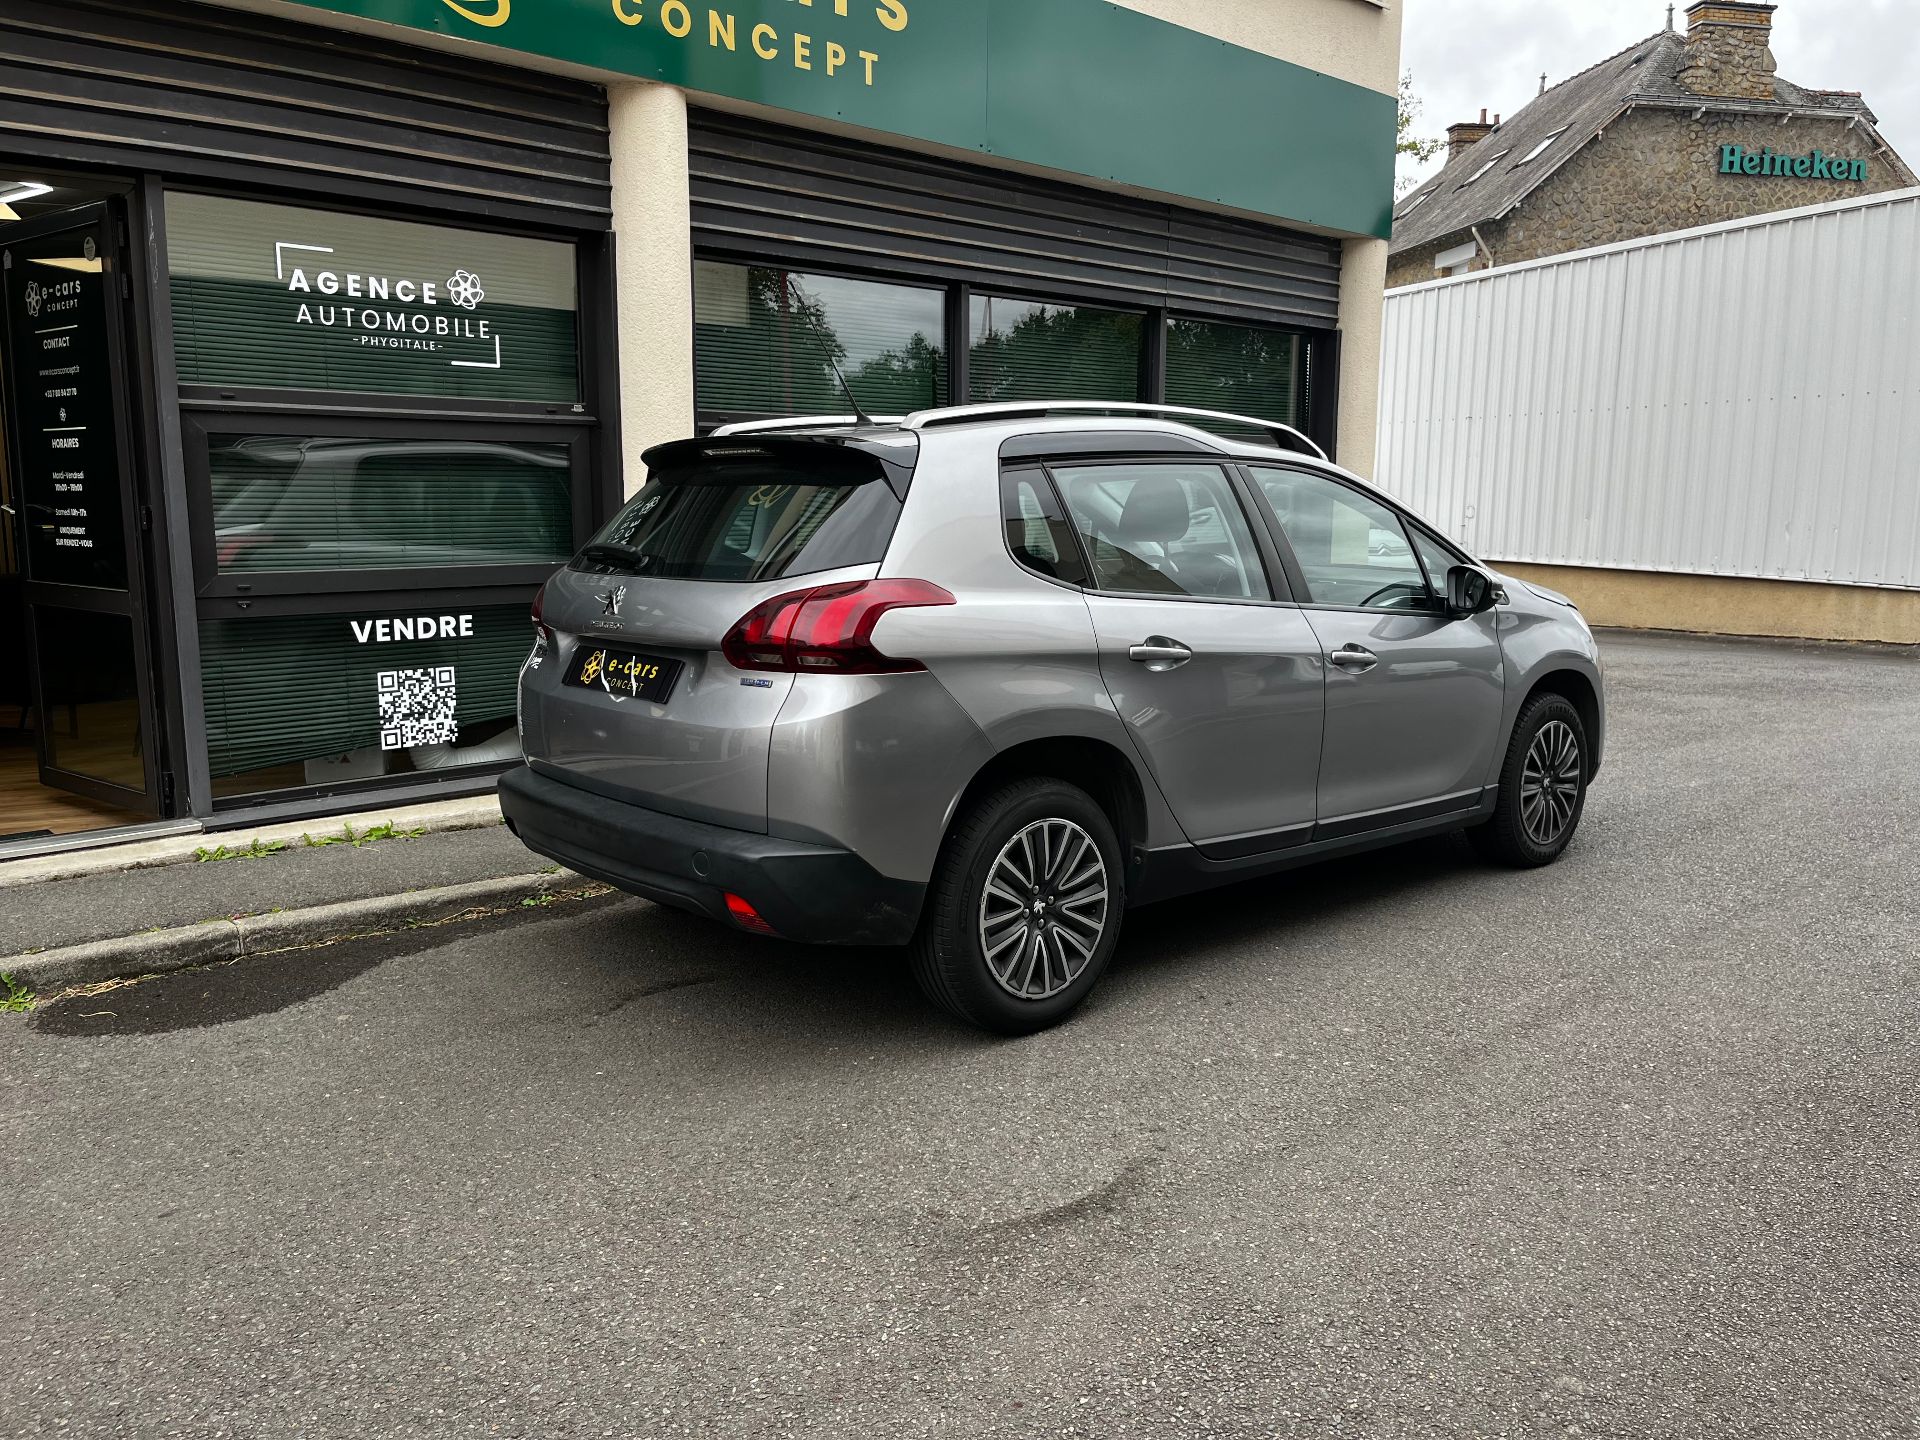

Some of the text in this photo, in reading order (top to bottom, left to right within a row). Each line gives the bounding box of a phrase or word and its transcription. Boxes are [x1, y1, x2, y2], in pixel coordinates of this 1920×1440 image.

[611, 0, 879, 86] CONCEPT
[1719, 143, 1868, 181] Heineken
[42, 280, 80, 299] e-cars
[288, 269, 437, 304] AGENCE
[47, 299, 77, 312] CONCEPT
[296, 303, 490, 339] AUTOMOBILE
[43, 336, 70, 349] CONTACT
[52, 438, 79, 448] HORAIRES
[350, 614, 474, 643] VENDRE
[608, 658, 660, 680] e-cars
